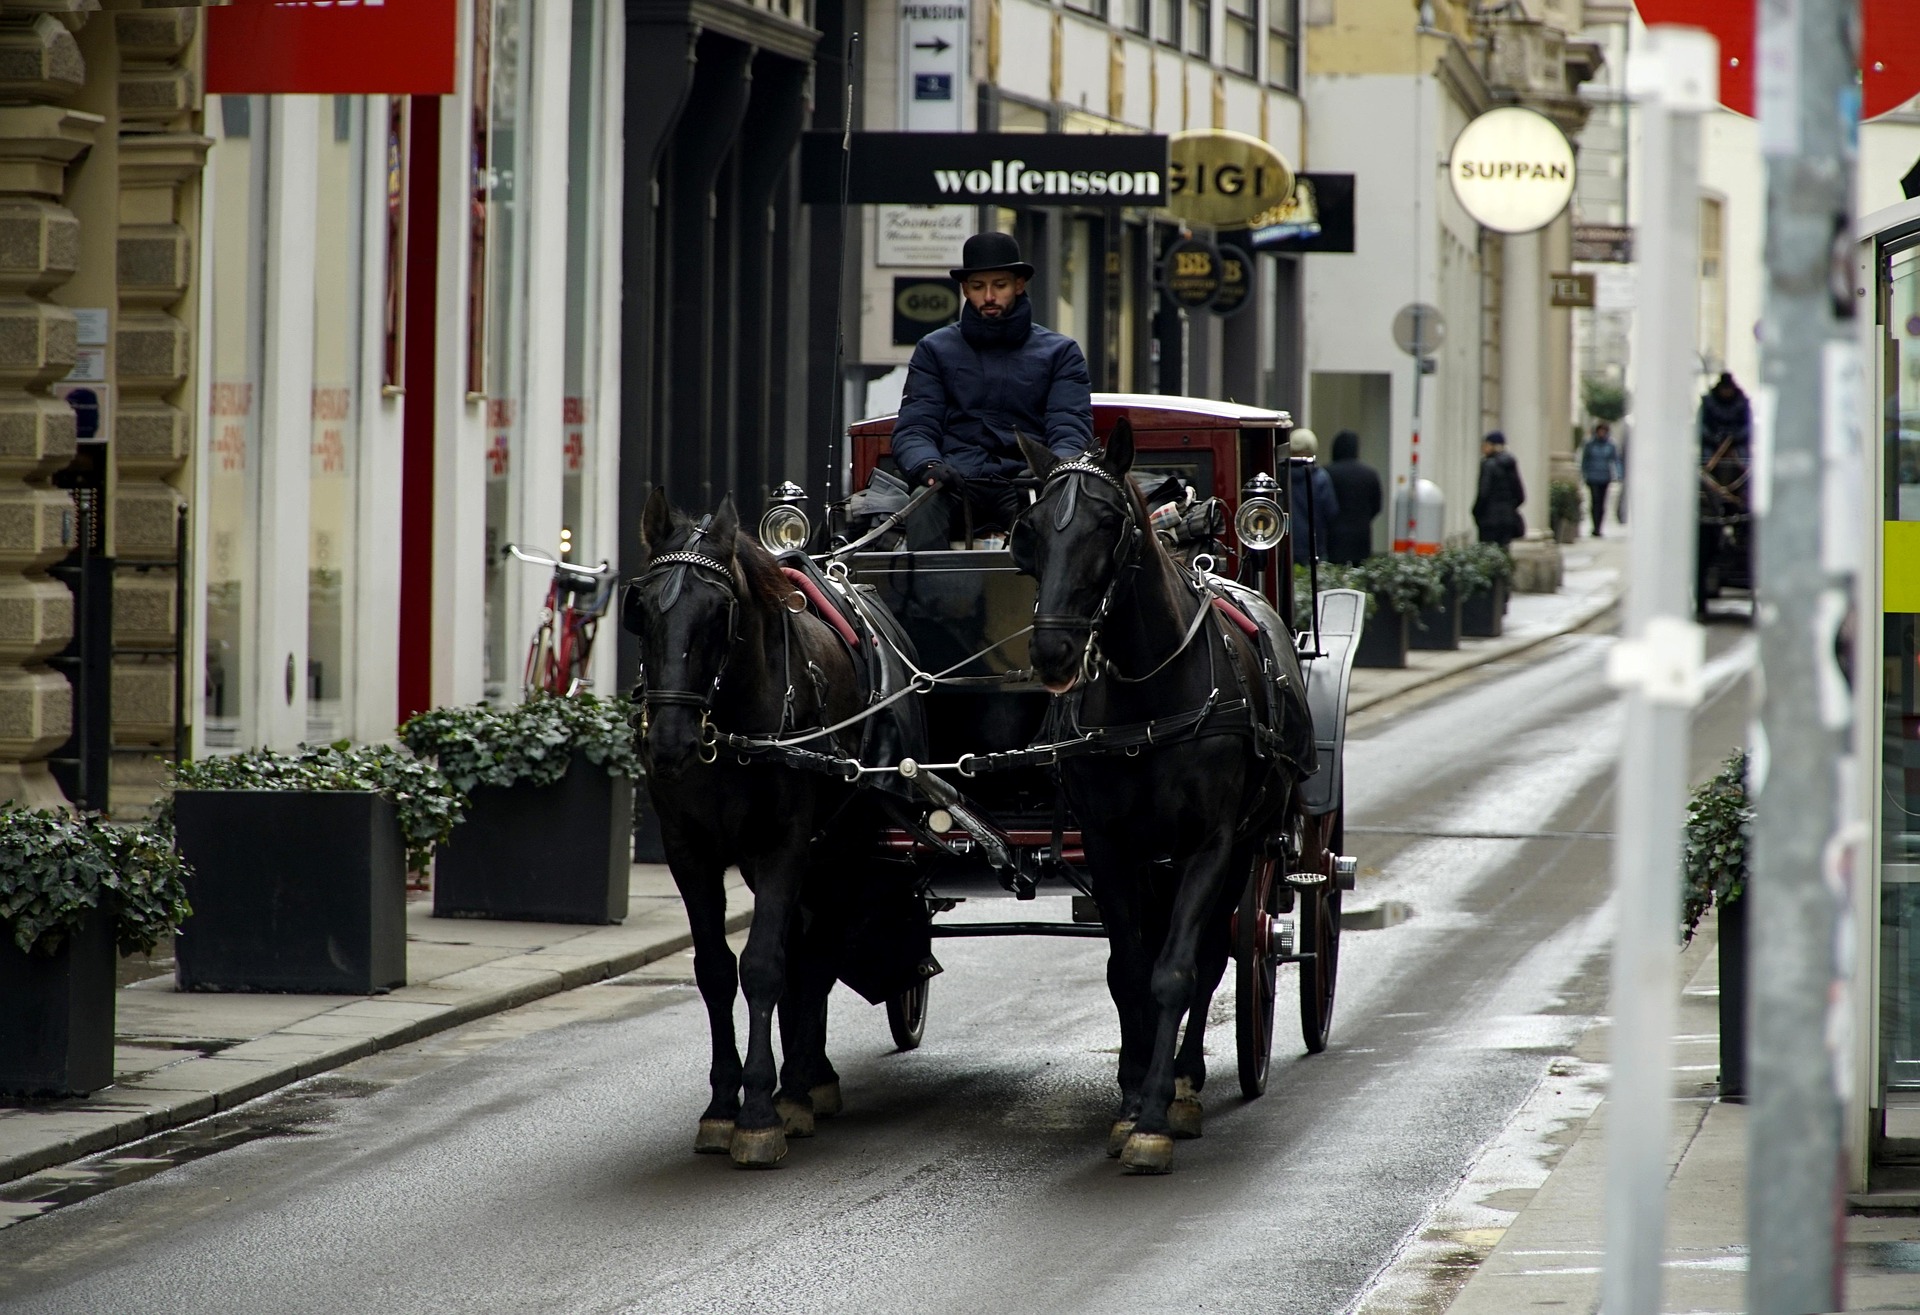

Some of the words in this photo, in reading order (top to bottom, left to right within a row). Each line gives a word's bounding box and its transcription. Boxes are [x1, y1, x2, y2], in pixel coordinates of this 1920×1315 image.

[903, 5, 964, 19] PENSION
[934, 159, 1160, 196] wolfensson
[1462, 161, 1567, 179] SUPPAN
[907, 293, 949, 311] GIGI
